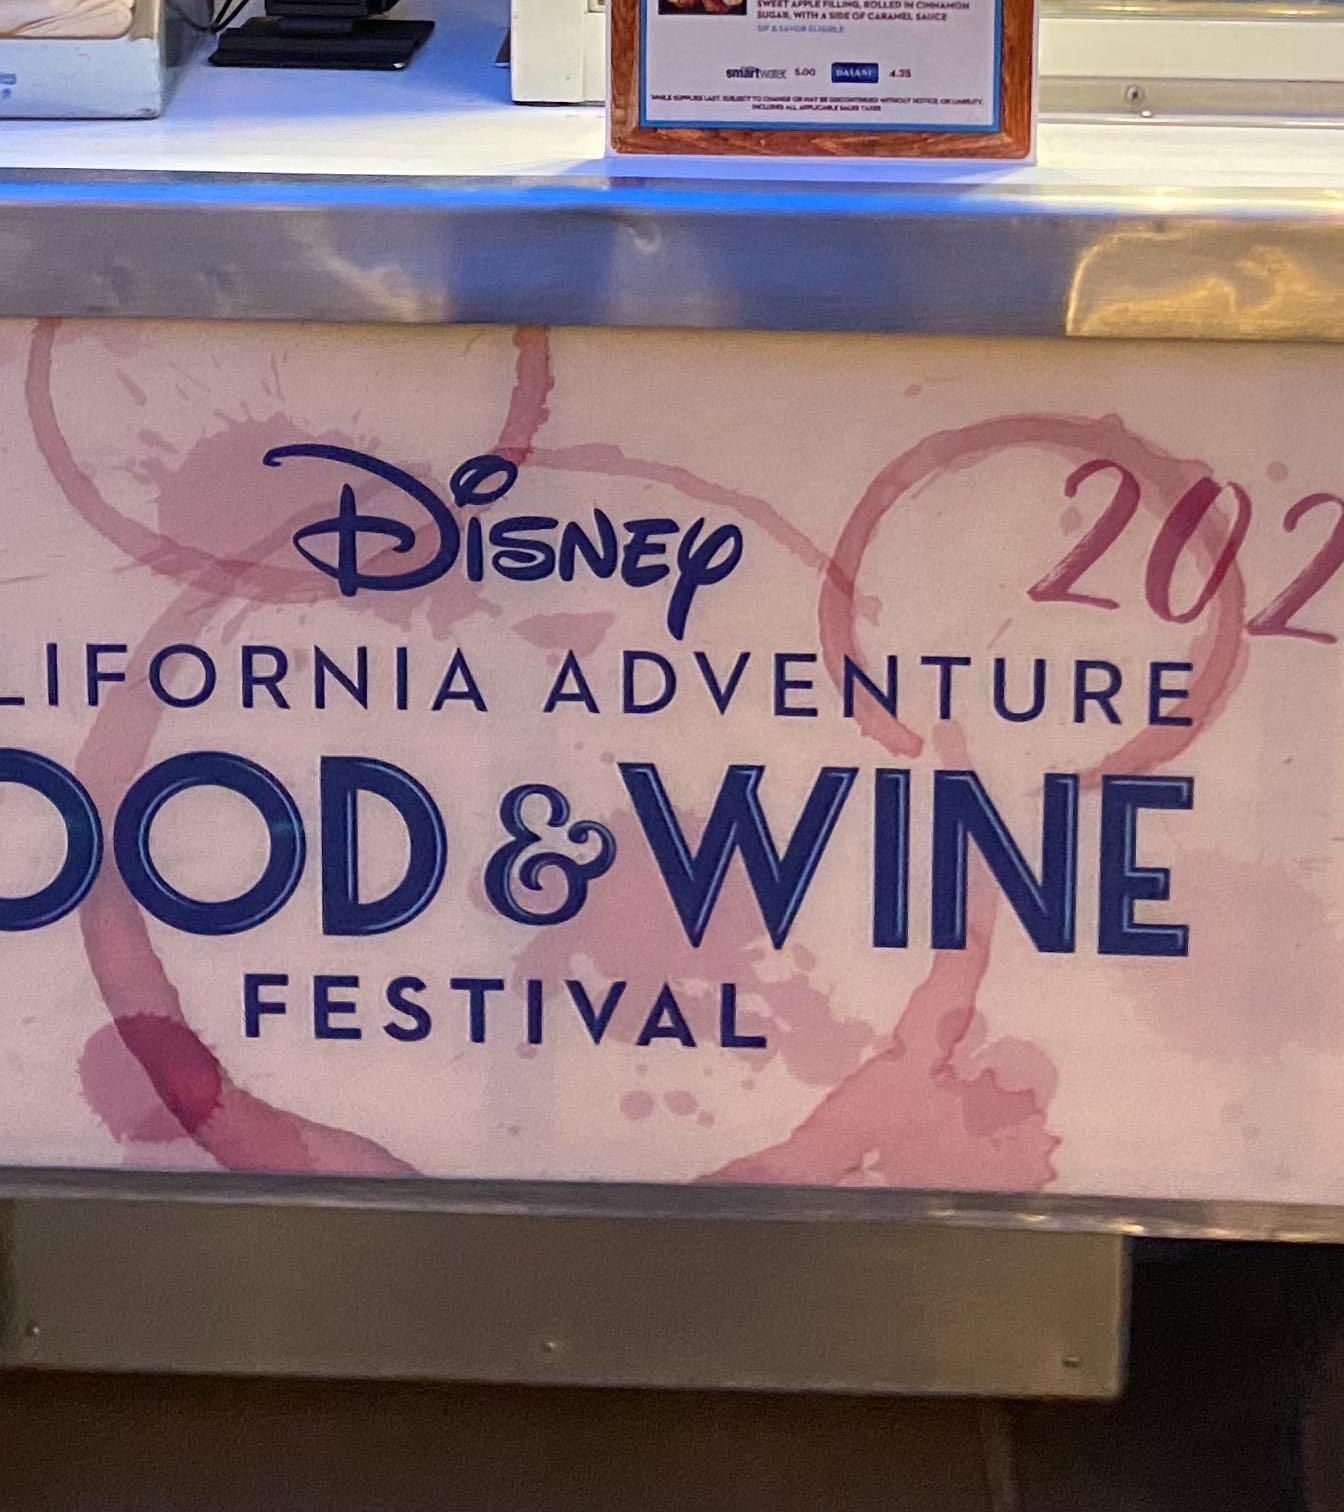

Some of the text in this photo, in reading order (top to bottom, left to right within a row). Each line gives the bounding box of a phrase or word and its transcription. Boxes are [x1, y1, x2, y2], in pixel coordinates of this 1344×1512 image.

[757, 0, 970, 10] SWEET APPLE FILLING, ROLLED IN CINNAMON
[793, 11, 819, 20] WITH
[820, 12, 827, 20] A
[829, 12, 850, 20] SIDE
[851, 12, 865, 20] OF
[867, 12, 914, 21] CARAMEL
[915, 12, 947, 21] SAUCE
[794, 67, 817, 76] 5.00
[888, 68, 912, 78] 4.25
[262, 443, 744, 641] Disney
[542, 648, 1196, 727] ADVENTURE
[483, 783, 618, 927] &
[617, 761, 1196, 958] WINE
[243, 971, 768, 1049] FESTIVAL
